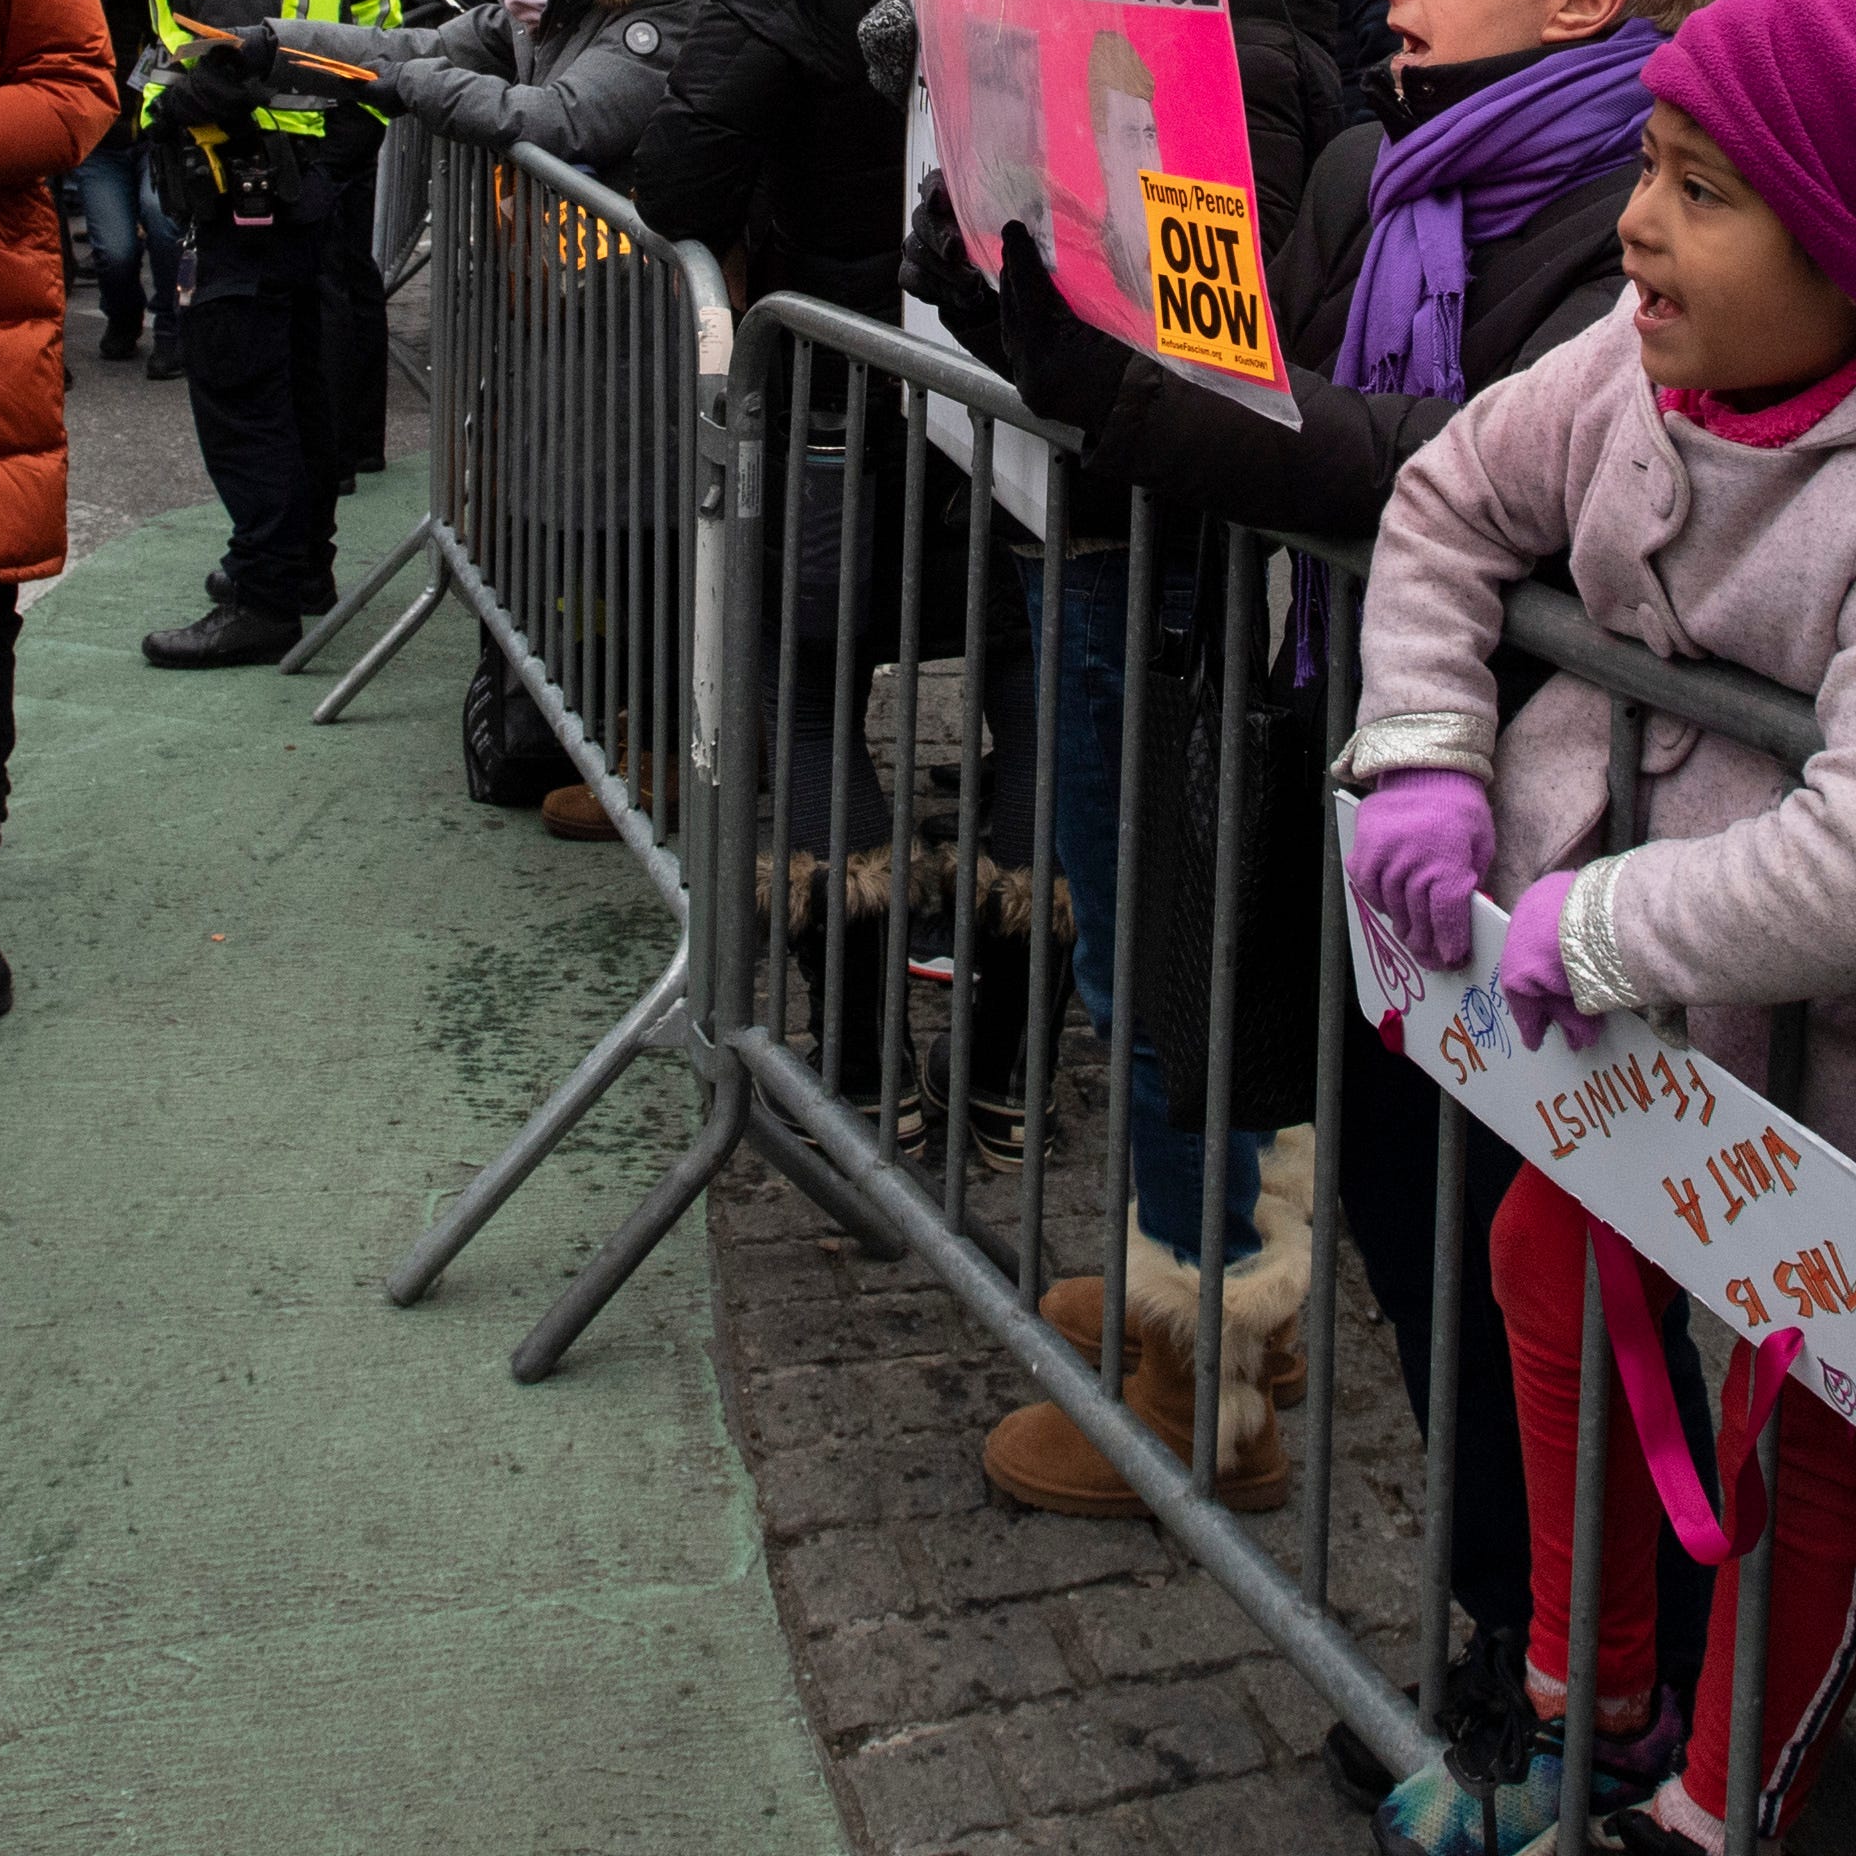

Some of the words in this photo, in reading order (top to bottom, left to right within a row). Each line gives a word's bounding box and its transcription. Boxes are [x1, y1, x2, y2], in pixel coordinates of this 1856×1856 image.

[1141, 176, 1245, 218] Trump/Pence
[1160, 216, 1241, 286] OUT
[1158, 274, 1258, 351] NOW
[1161, 338, 1223, 361] RefuseFascism.org
[1534, 1050, 1715, 1160] FEMINIST
[1661, 1176, 1712, 1245] A
[1707, 1126, 1801, 1225] WHAT
